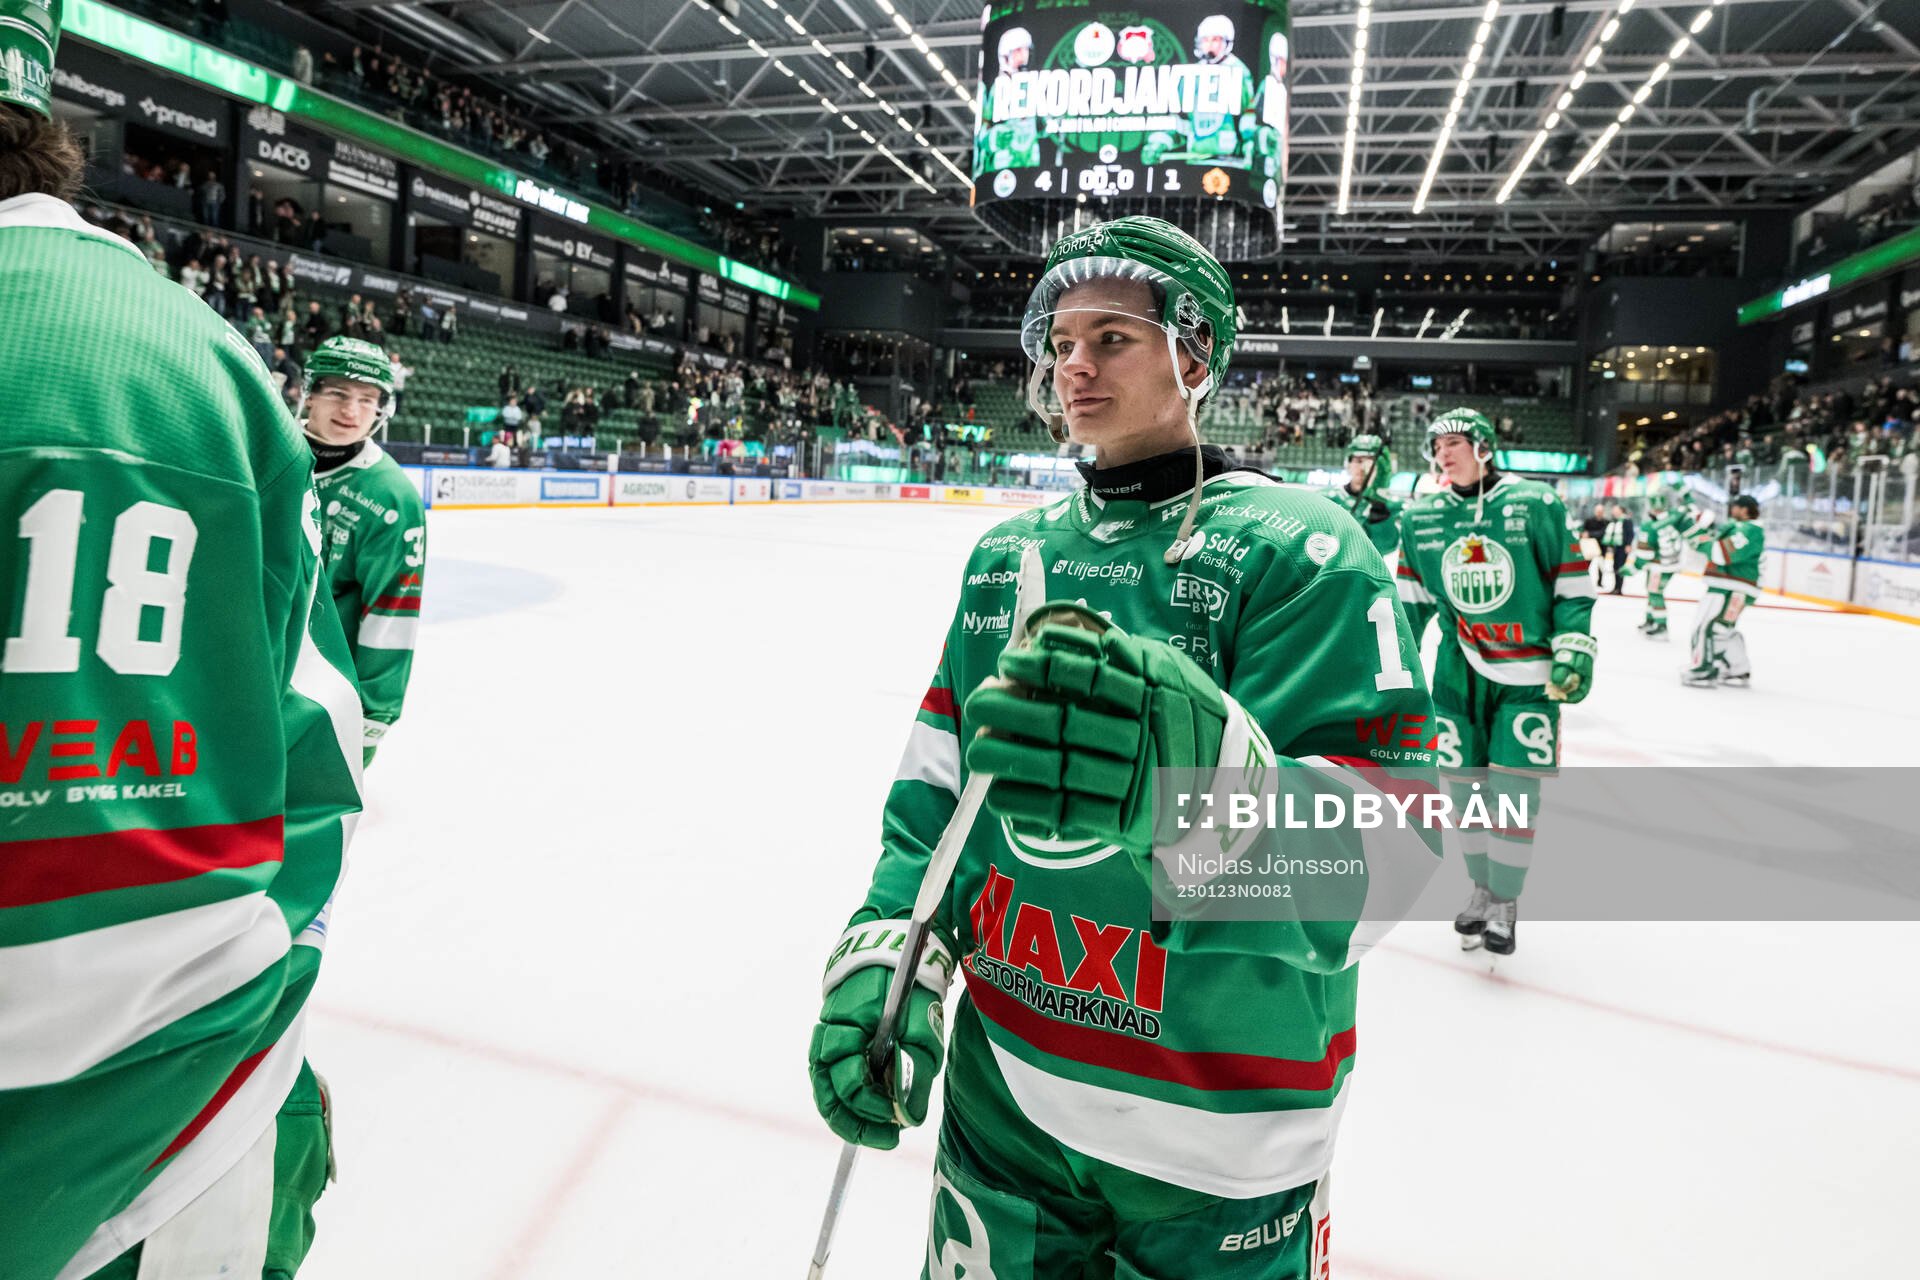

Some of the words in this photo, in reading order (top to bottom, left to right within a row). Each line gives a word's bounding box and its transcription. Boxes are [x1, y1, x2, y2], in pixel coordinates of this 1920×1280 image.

[992, 64, 1243, 122] REKORDJAKTEN
[157, 104, 218, 138] prenad
[1035, 170, 1052, 191] 4
[1164, 169, 1181, 191] 1
[1241, 340, 1279, 353] Arena
[2, 488, 198, 677] 18
[1109, 578, 1140, 587] group
[1466, 621, 1524, 643] AXI
[1370, 749, 1401, 760] GOLV
[0, 790, 52, 807] OLV
[122, 783, 187, 799] KAKEL
[977, 956, 1161, 1039] STORMARKNAD
